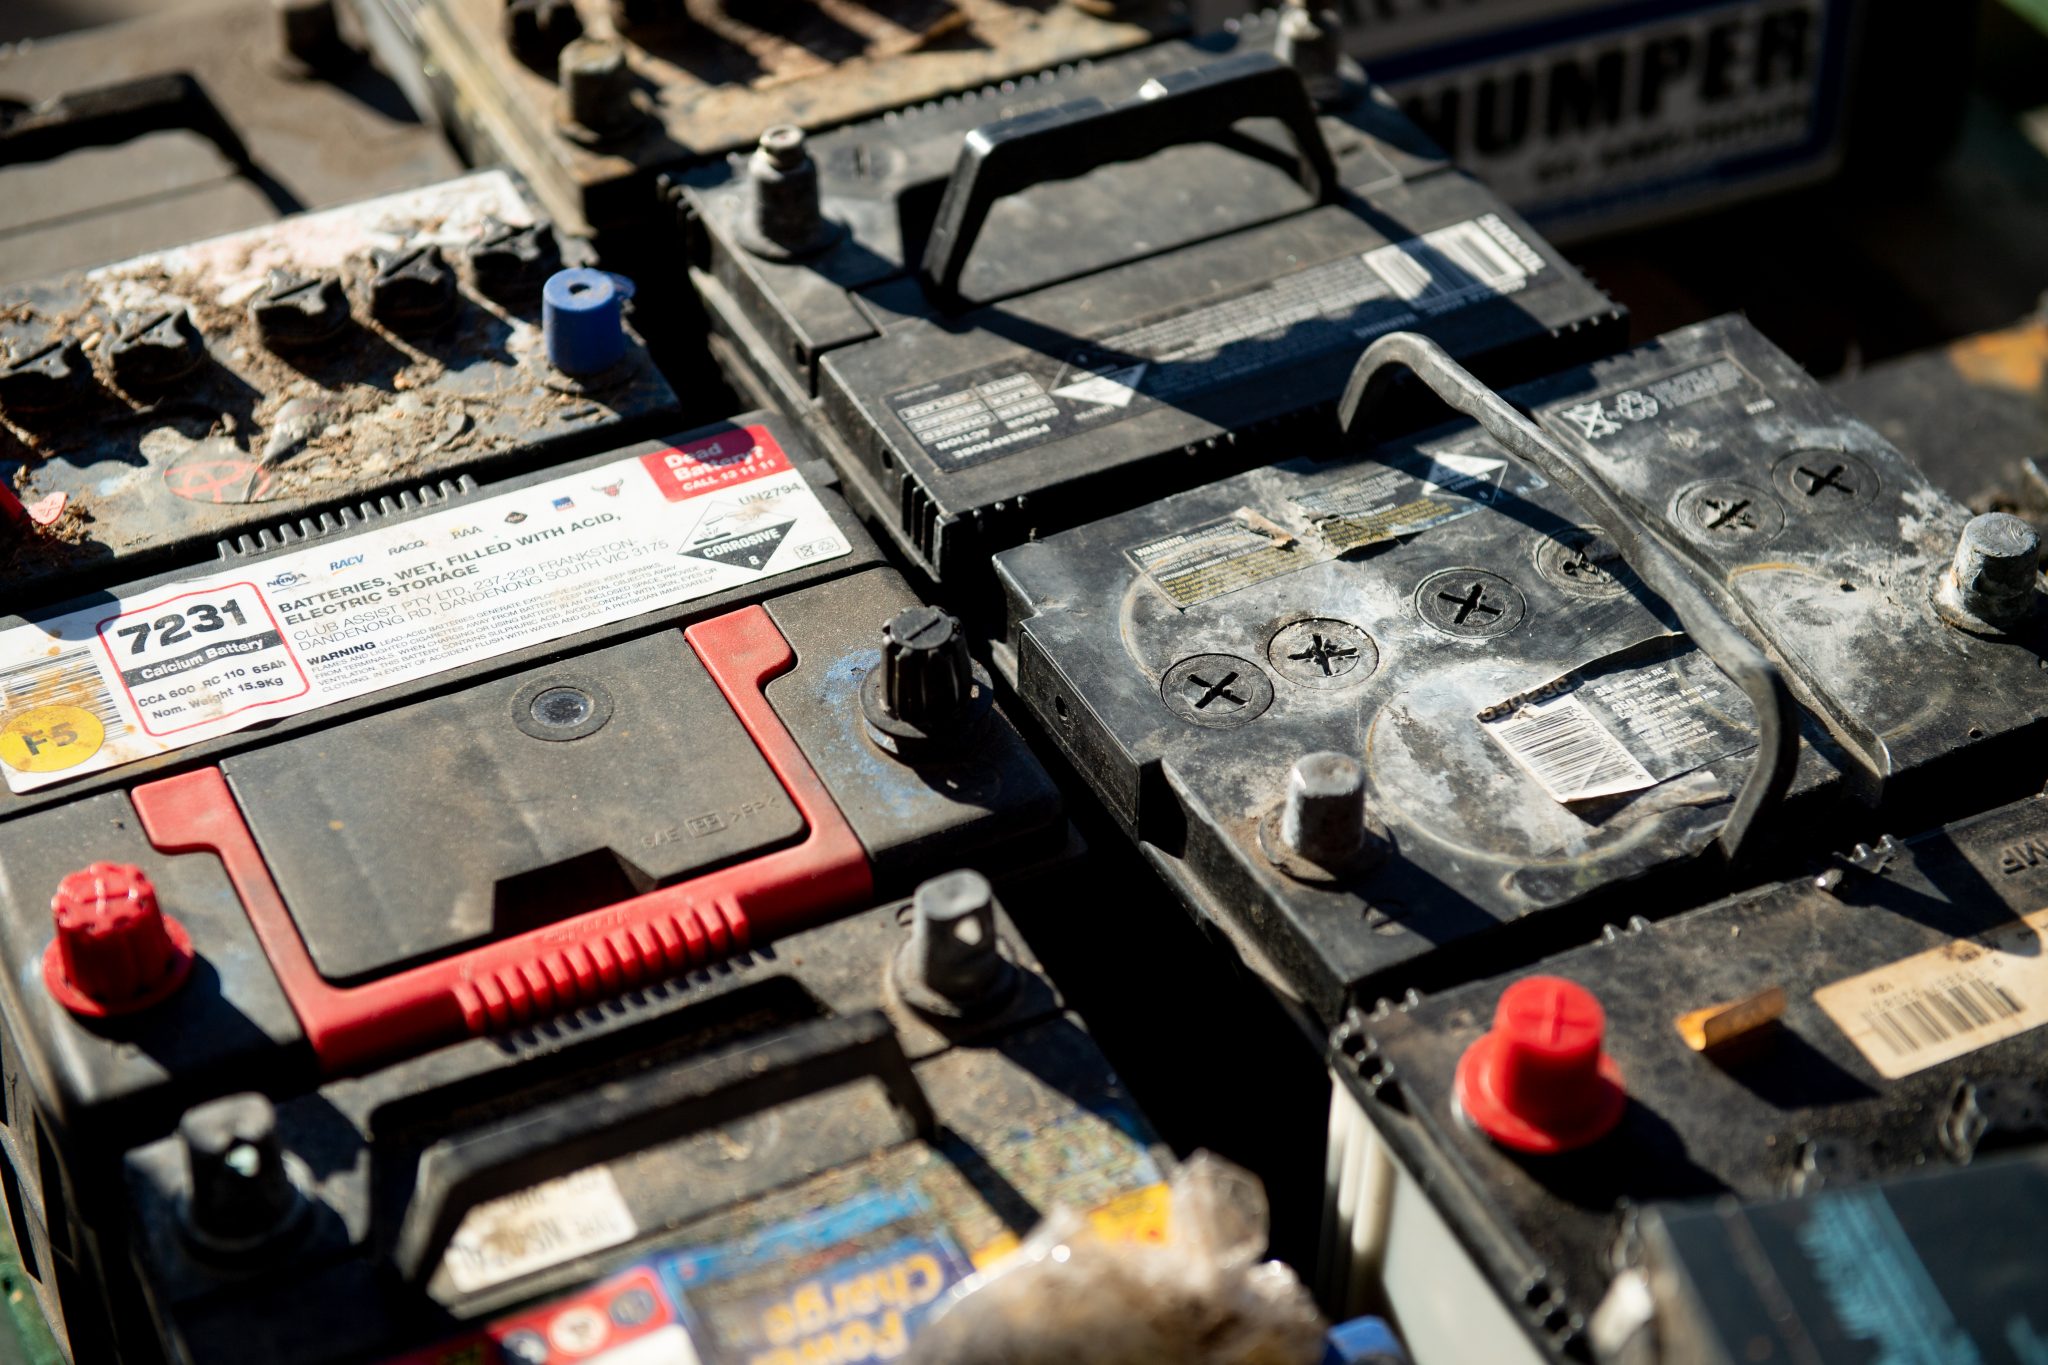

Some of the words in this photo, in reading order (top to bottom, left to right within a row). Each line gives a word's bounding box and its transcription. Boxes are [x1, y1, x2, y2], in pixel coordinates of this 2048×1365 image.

[1005, 407, 1058, 428] COLOUR
[664, 442, 721, 468] Dead
[935, 427, 989, 450] ACTION
[952, 423, 1049, 457] POWERPROBE
[675, 445, 763, 480] Battery?
[683, 475, 719, 490] CALL
[720, 470, 737, 480] 13
[740, 464, 756, 475] 11
[759, 458, 775, 469] 11
[738, 482, 801, 505] UN2794
[388, 539, 425, 556] RACQ
[451, 525, 483, 539] RAA
[703, 528, 780, 558] CORROSIVE
[1134, 535, 1187, 557] WARNING
[278, 577, 391, 613] BATTERIES,
[394, 561, 443, 580] WET,
[446, 541, 511, 566] FILLED
[515, 526, 565, 546] WITH
[570, 512, 621, 532] ACID,
[329, 553, 364, 571] RACV
[748, 555, 759, 565] 8
[264, 570, 308, 589] NRMA
[285, 591, 382, 625] ELECTRIC
[387, 564, 479, 596] STORAGE
[293, 621, 339, 641] CLUB
[343, 604, 396, 627] ASSIST
[401, 593, 431, 610] PTY
[473, 566, 536, 590] 237-239
[538, 538, 634, 571] FRANKSTON-
[298, 614, 405, 650] DANDENONG
[407, 606, 437, 620] RD,
[439, 575, 542, 611] DANDENONG
[544, 558, 600, 581] SOUTH
[602, 550, 629, 564] VIC
[631, 539, 669, 556] 3175
[118, 599, 245, 653] 7231
[307, 641, 376, 665] WARNING
[428, 615, 475, 631] BATTERIES
[476, 601, 519, 617] GENERATE
[311, 658, 347, 673] FLAMES
[349, 652, 368, 662] AND
[369, 640, 408, 656] LIGHTED
[409, 626, 464, 645] CIGARETTES
[466, 617, 489, 629] AWAY
[491, 609, 518, 621] FROM
[559, 591, 582, 602] KEEP
[583, 583, 611, 594] METAL
[612, 572, 652, 587] OBJECTS
[653, 564, 676, 575] AWAY
[314, 667, 342, 679] FROM
[397, 643, 426, 655] WHEN
[426, 629, 474, 647] CHARGING
[475, 625, 490, 633] OR
[490, 617, 519, 629] USING
[519, 605, 557, 620] BATTERY
[571, 598, 583, 606] AN
[584, 585, 631, 602] ENCLOSED
[663, 566, 698, 580] PROVIDE
[379, 658, 400, 668] THIS
[401, 647, 439, 661] BATTERY
[441, 633, 486, 650] CONTAINS
[487, 618, 538, 636] SULPHURIC
[565, 603, 591, 615] AVOID
[591, 592, 631, 607] CONTACT
[632, 585, 656, 595] WITH
[680, 572, 703, 582] EYES
[703, 567, 717, 575] OR
[383, 661, 412, 674] EVENT
[413, 658, 425, 666] OF
[429, 644, 472, 661] ACCIDENT
[474, 635, 504, 648] FLUSH
[505, 629, 528, 639] WITH
[528, 620, 560, 632] WATER
[561, 614, 580, 624] AND
[580, 609, 600, 617] CALL
[612, 592, 658, 609] PHYSICIAN
[141, 654, 203, 679] Calcium
[205, 638, 263, 658] Battery
[137, 693, 167, 707] CCA
[168, 684, 196, 698] 600
[201, 675, 221, 688] RC
[223, 667, 245, 679] 110
[251, 659, 286, 674] 65Ah
[1614, 672, 1652, 687] Minutes
[1650, 666, 1666, 676] RC
[1637, 671, 1679, 690] Capacity
[151, 705, 186, 719] Nom.
[188, 687, 234, 708] Weight
[237, 677, 284, 691] 15.9Kg
[1638, 691, 1659, 702] CCA
[1640, 692, 1681, 713] Cranking
[1679, 683, 1707, 696] Amps
[23, 722, 77, 756] F5
[763, 1254, 945, 1346] Charge
[748, 1309, 906, 1365] Pow
